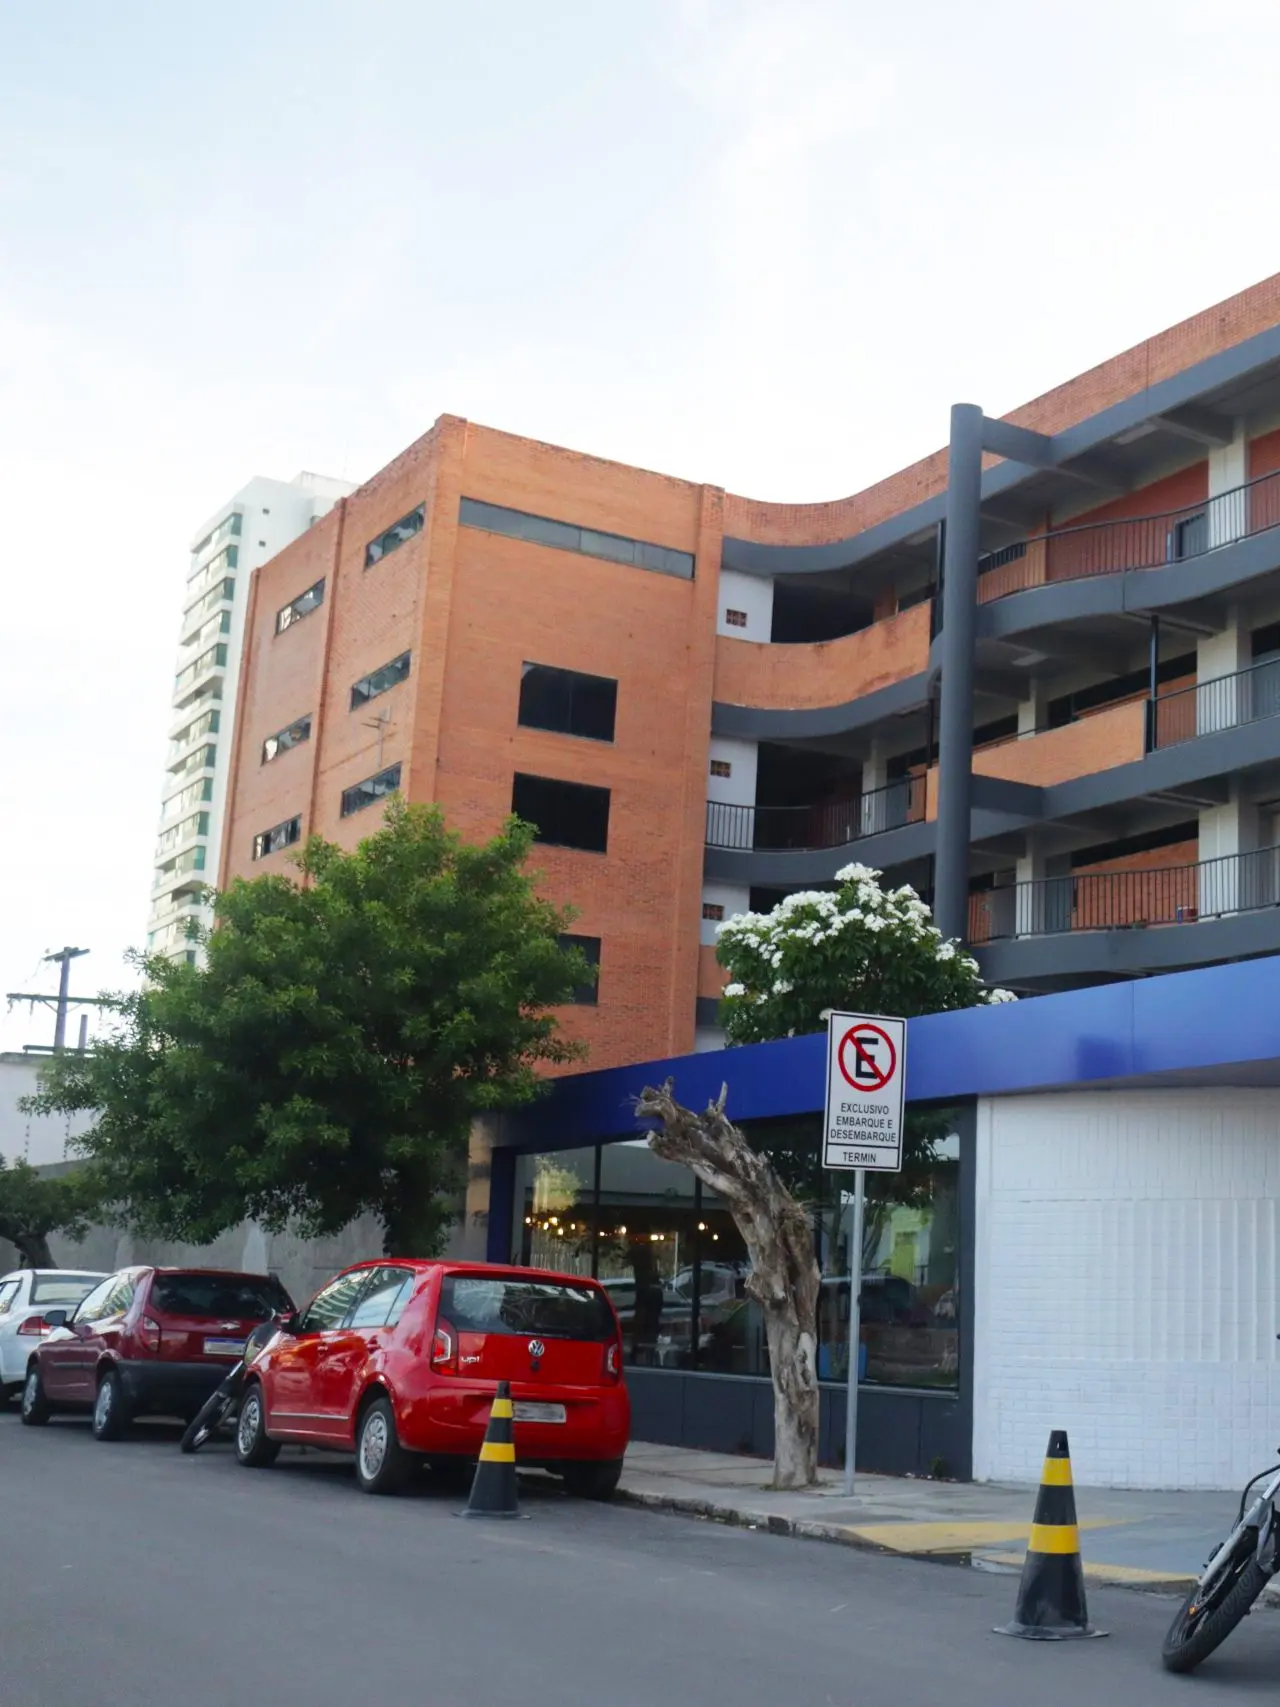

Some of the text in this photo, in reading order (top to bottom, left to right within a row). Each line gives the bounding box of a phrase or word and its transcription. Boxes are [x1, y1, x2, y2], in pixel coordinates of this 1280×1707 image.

[840, 1103, 890, 1115] EXCLUSIVO
[836, 1115, 893, 1129] EMBARQUE E
[830, 1129, 896, 1143] DESEMBARQUE
[843, 1151, 877, 1163] TERMIN
